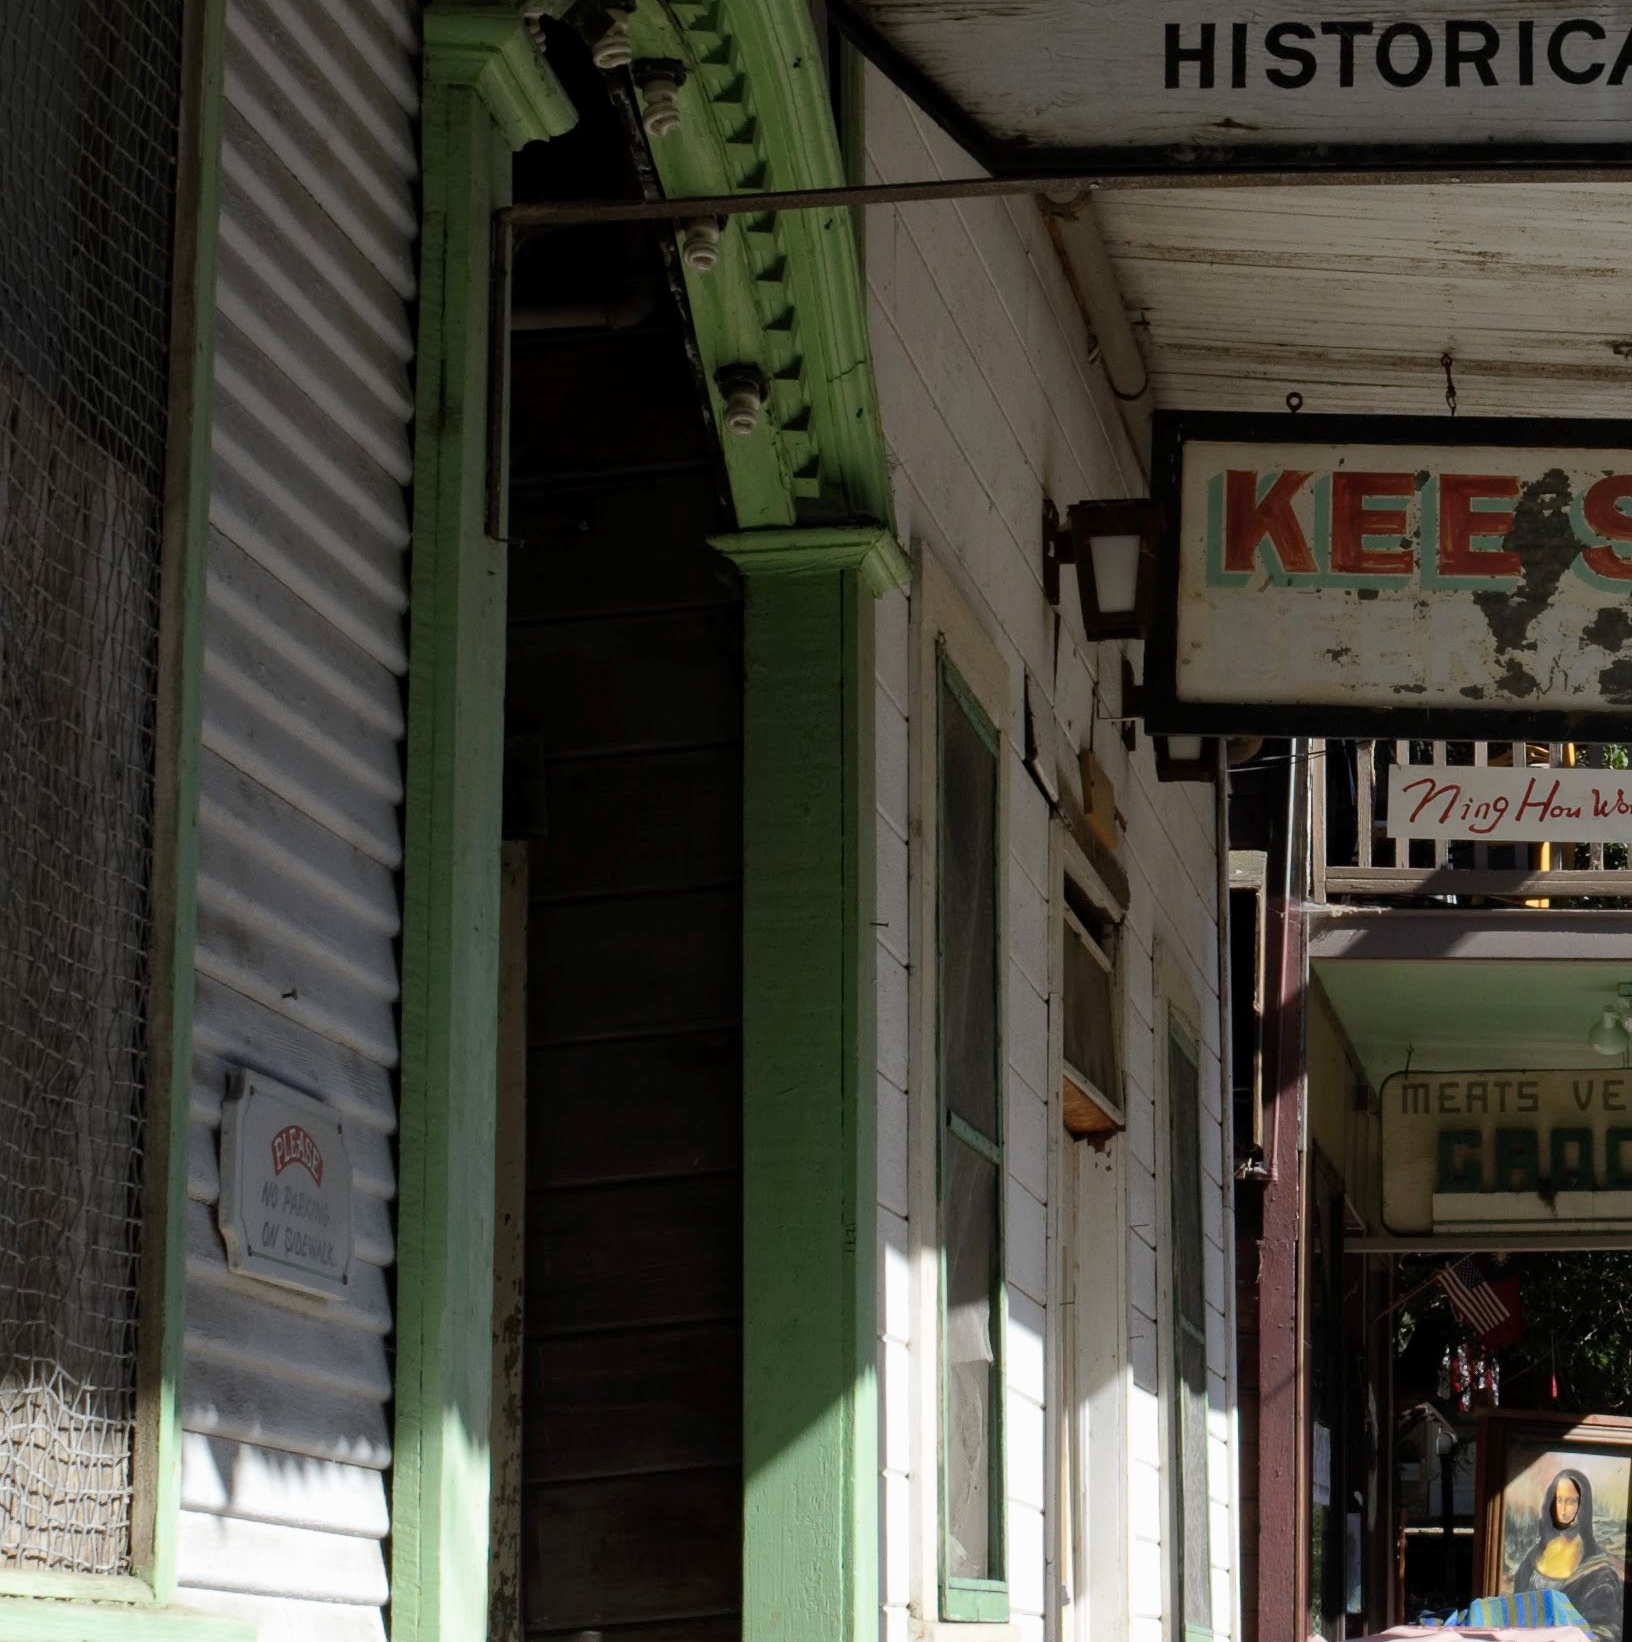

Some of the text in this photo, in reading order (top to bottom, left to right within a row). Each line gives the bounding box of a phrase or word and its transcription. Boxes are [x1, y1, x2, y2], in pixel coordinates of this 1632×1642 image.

[1207, 468, 1523, 591] KEE
[1402, 777, 1509, 835] Ning
[1401, 1080, 1540, 1115] MEATS
[273, 1127, 323, 1180] PLEASE
[261, 1180, 331, 1230] NO PARKING
[261, 1220, 337, 1268] ON SIDEWALK
